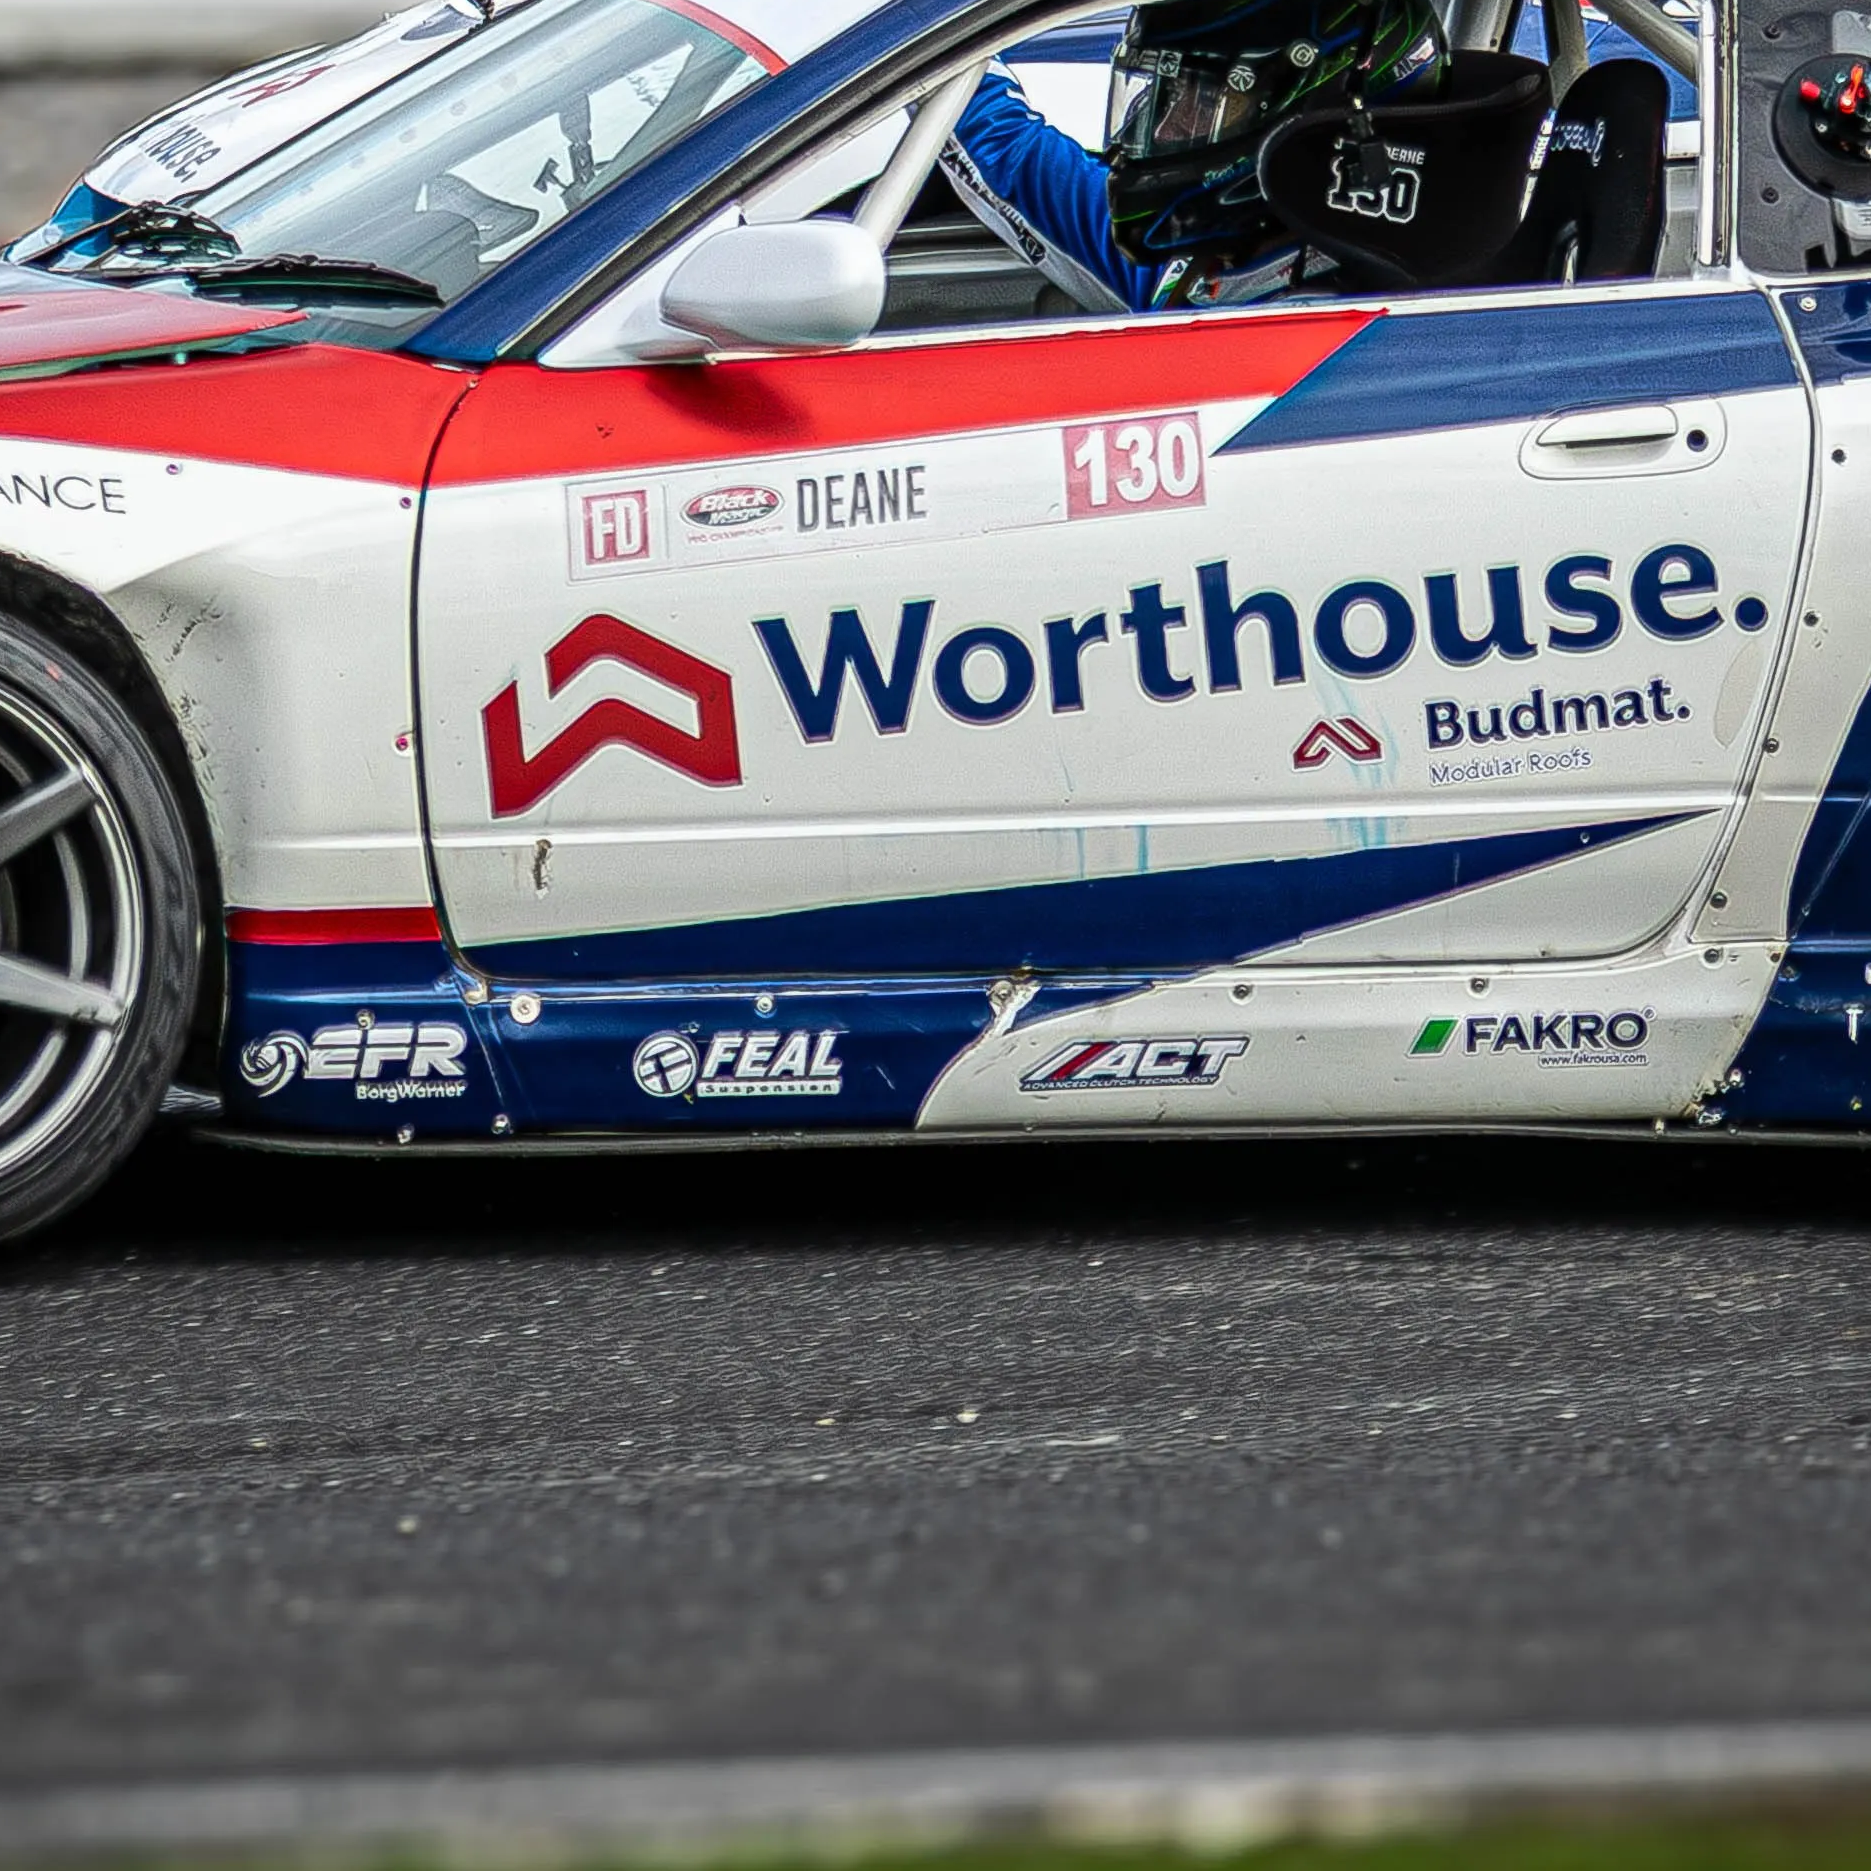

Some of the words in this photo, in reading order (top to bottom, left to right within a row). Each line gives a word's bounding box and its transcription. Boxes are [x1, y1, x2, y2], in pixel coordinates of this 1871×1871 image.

[1066, 420, 1200, 507] 130
[796, 465, 928, 532] DEANE
[590, 497, 644, 560] FD
[751, 539, 1769, 746] Worthouse.
[1424, 677, 1692, 750] Budmat.
[1430, 755, 1524, 785] Modular
[1529, 747, 1593, 773] Roofs
[302, 1022, 467, 1080] EFR
[701, 1030, 843, 1079] FEAL
[1465, 1012, 1649, 1053] FAKRO
[1060, 1036, 1249, 1080] ACT
[1540, 1053, 1648, 1066] www.fakrousa.com
[355, 1081, 467, 1103] BorgWarner
[703, 1082, 833, 1096] Suspension
[1023, 1081, 1088, 1091] ADVANCED
[1090, 1078, 1137, 1087] CLUTCH
[1138, 1075, 1217, 1085] TECHNOLOGY
